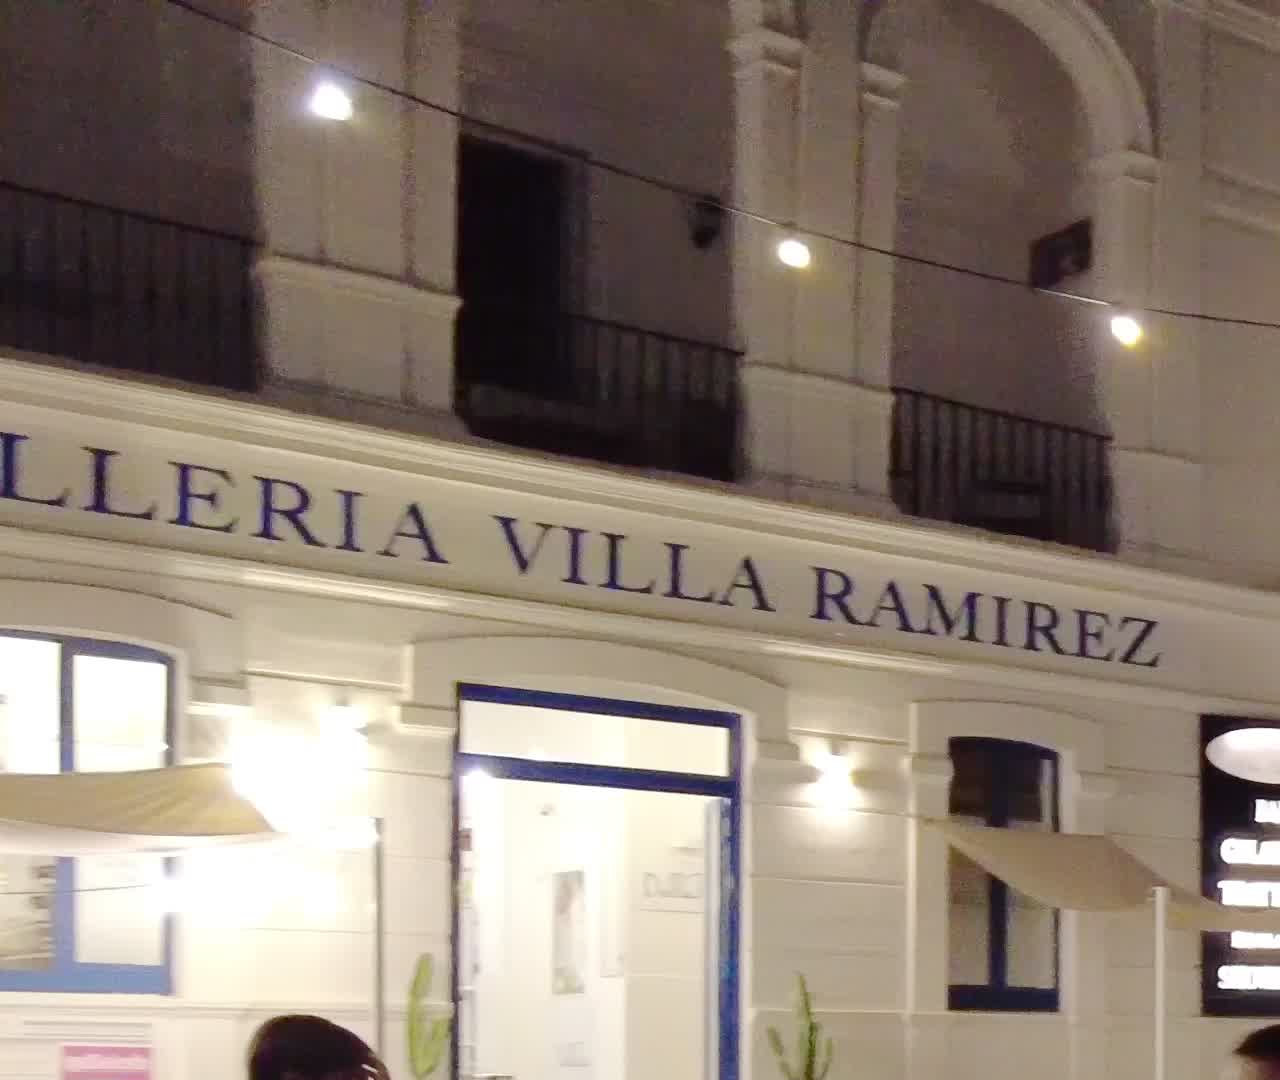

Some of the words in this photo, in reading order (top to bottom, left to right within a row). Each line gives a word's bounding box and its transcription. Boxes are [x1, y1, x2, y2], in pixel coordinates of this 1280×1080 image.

[0, 431, 450, 564] LLERIA
[494, 514, 777, 613] VILLA
[809, 565, 1162, 668] RAMIREZ
